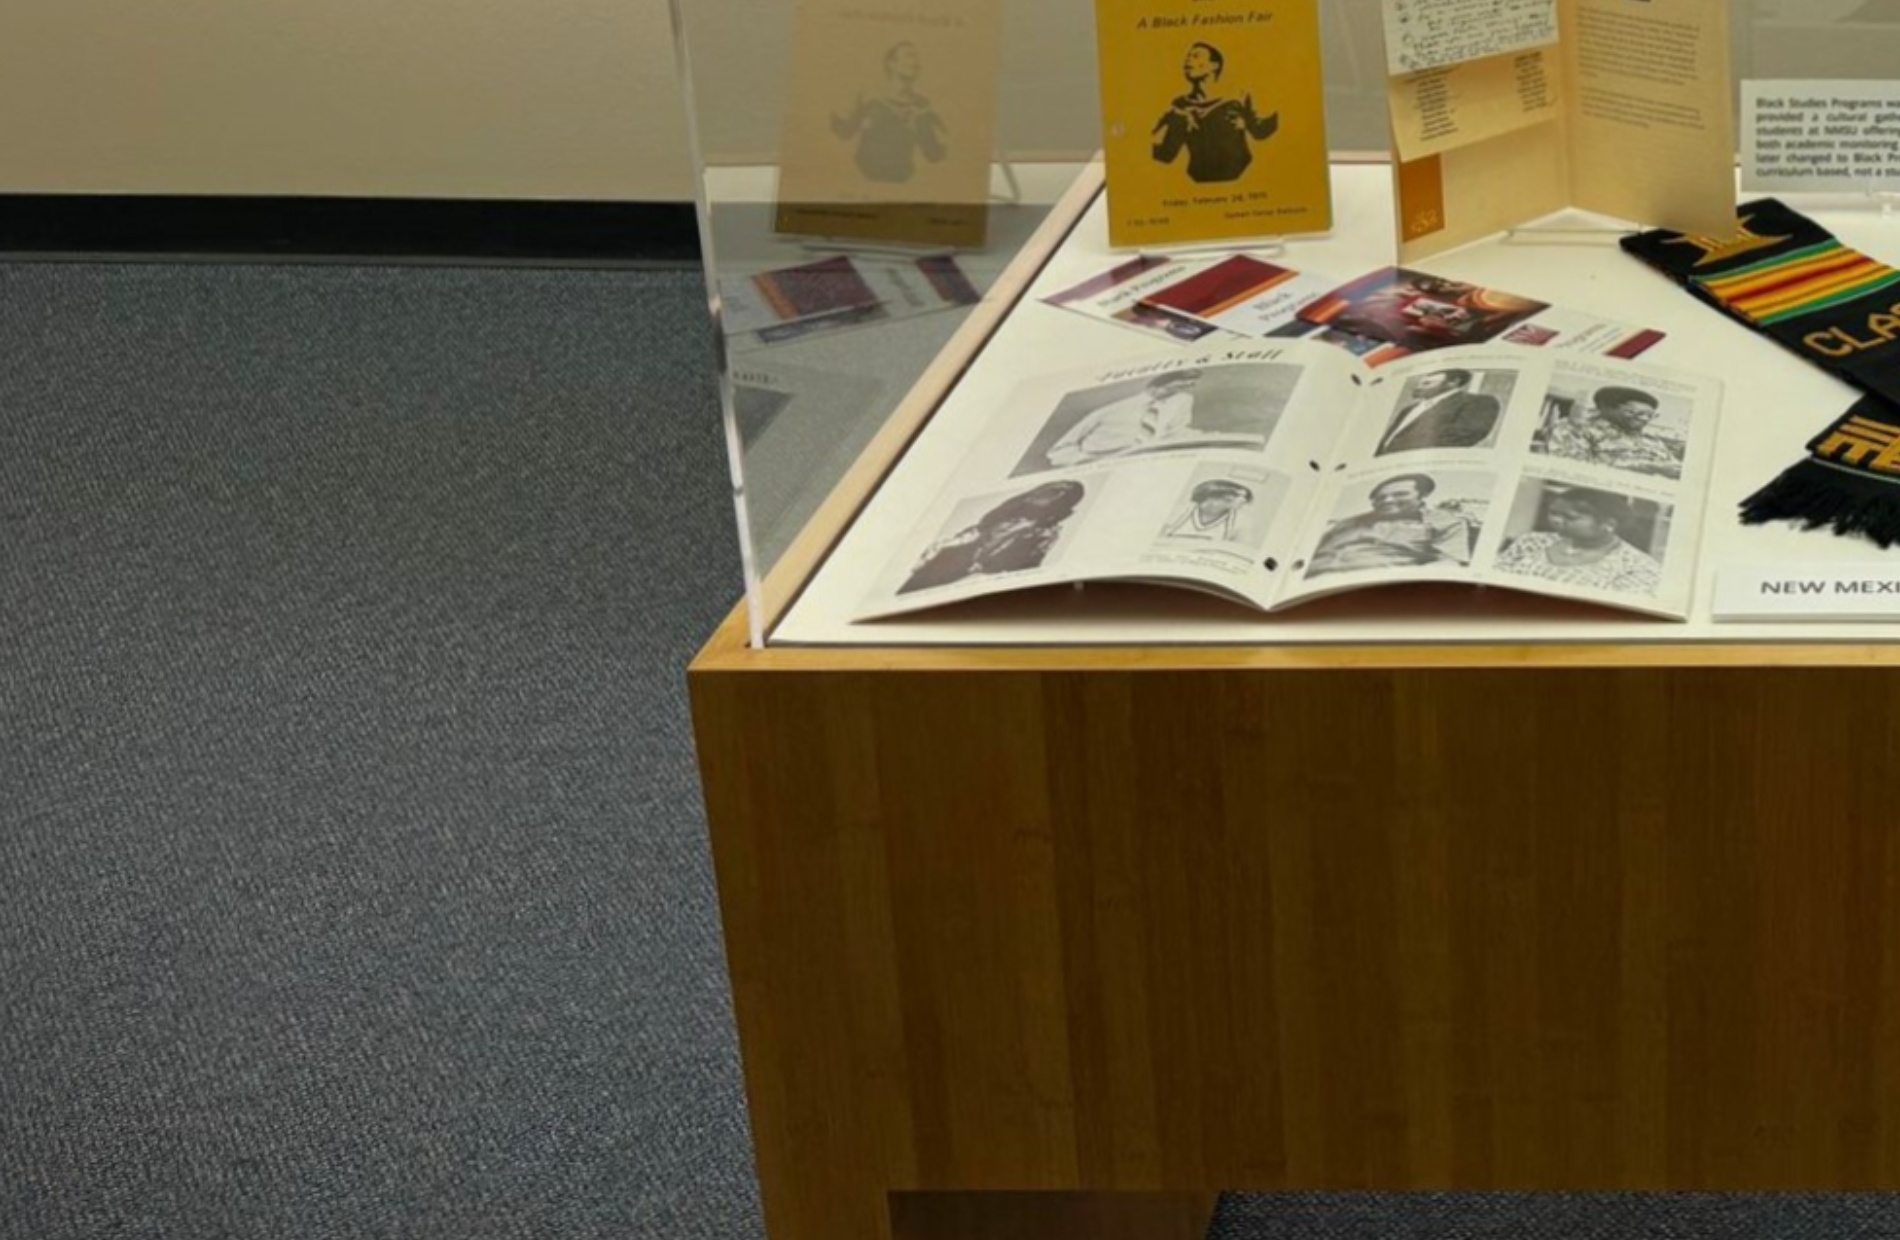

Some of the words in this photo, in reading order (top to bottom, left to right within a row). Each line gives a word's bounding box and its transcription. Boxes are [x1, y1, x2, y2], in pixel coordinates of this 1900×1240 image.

[1137, 18, 1148, 29] A
[1151, 14, 1187, 28] Black
[1192, 13, 1244, 27] Fashion
[1248, 11, 1273, 23] Fair
[1756, 97, 1785, 109] Black
[1788, 97, 1827, 109] Studies
[1830, 97, 1882, 111] Programs
[1756, 111, 1804, 125] provided
[1812, 114, 1819, 122] a
[1826, 111, 1867, 122] cultural
[1756, 125, 1804, 136] students
[1808, 125, 1820, 136] at
[1824, 125, 1858, 136] NMSU
[1756, 138, 1781, 149] both
[1784, 138, 1835, 149] academic
[1838, 138, 1899, 152] monitoring
[1756, 152, 1780, 163] later
[1786, 152, 1832, 165] changed
[1836, 152, 1848, 163] to
[1853, 152, 1882, 163] Black
[1756, 165, 1813, 176] curriculum
[1817, 165, 1852, 179] based,
[1853, 165, 1873, 176] not
[1875, 168, 1882, 176] a
[1759, 579, 1827, 595] NEW
